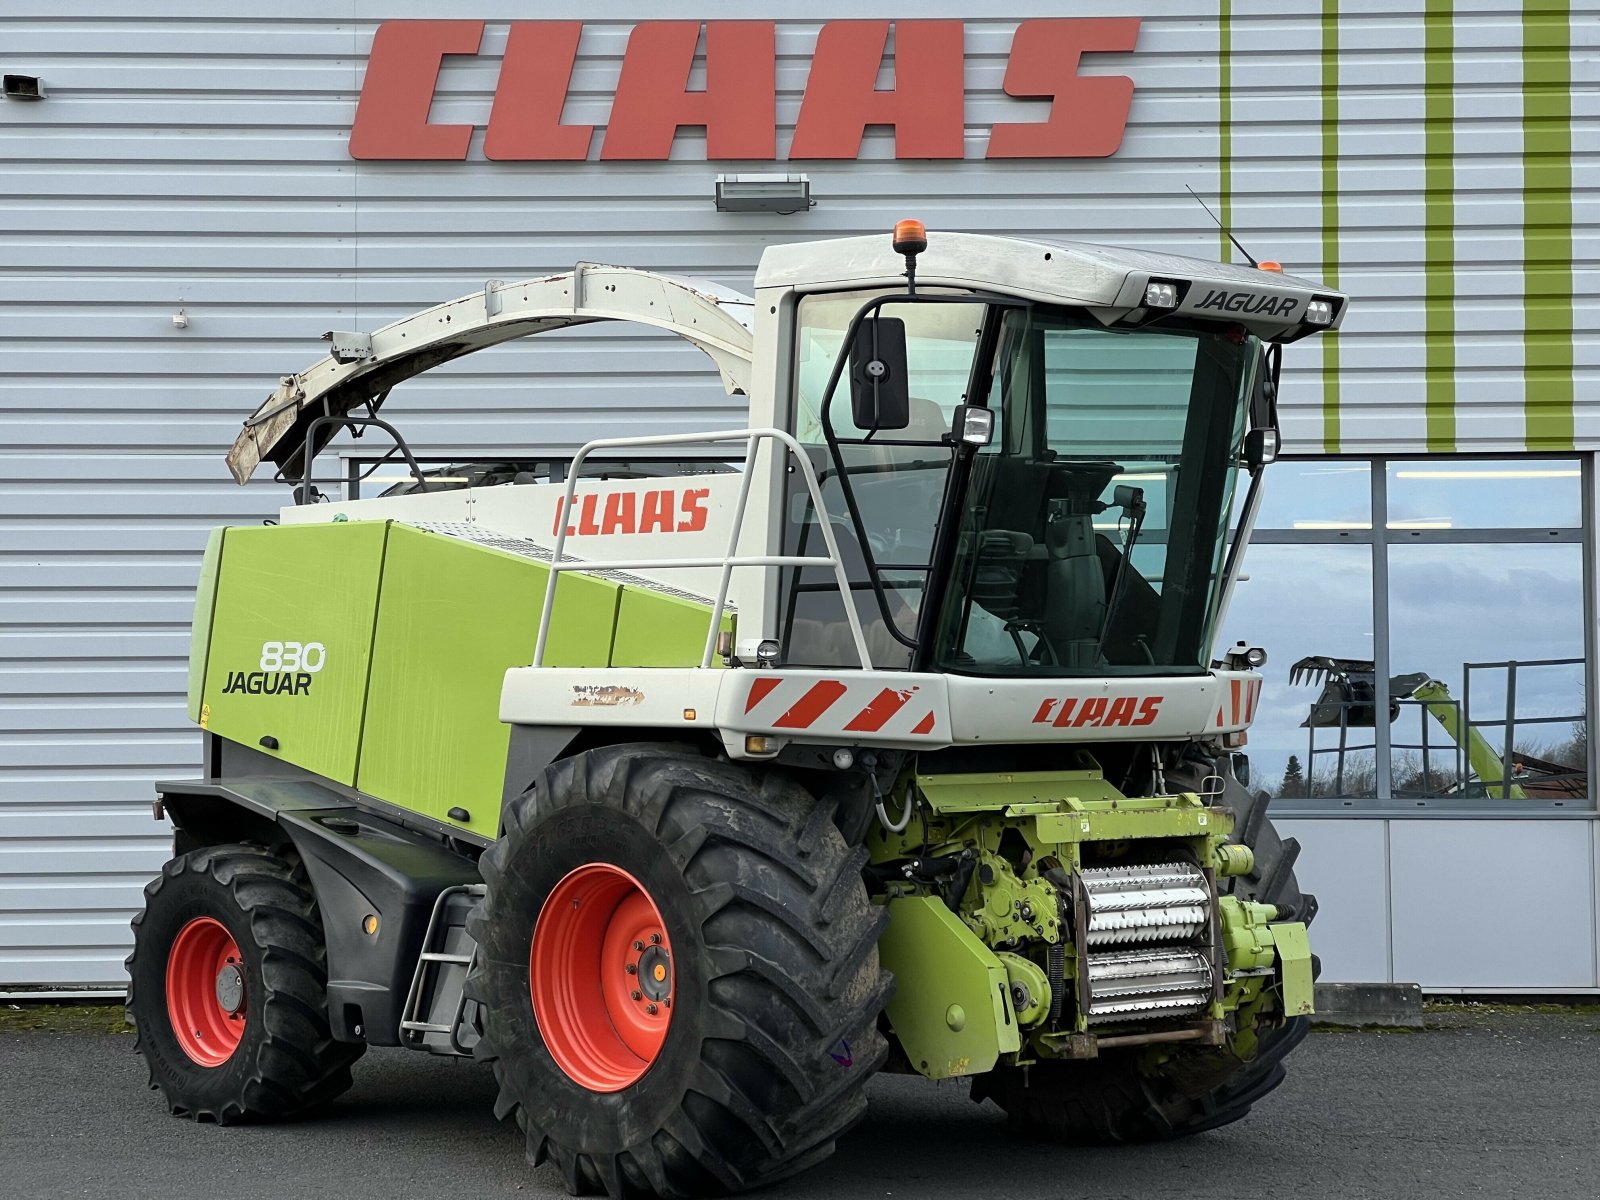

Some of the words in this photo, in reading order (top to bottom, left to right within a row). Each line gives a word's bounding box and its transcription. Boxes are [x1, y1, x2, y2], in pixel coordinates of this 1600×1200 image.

[348, 17, 1142, 161] CLAAS
[1193, 289, 1299, 317] JAGUAR
[552, 488, 710, 537] CLAAS
[259, 641, 326, 673] 830
[221, 671, 312, 696] JAGUAR
[1031, 696, 1164, 728] CLAAS
